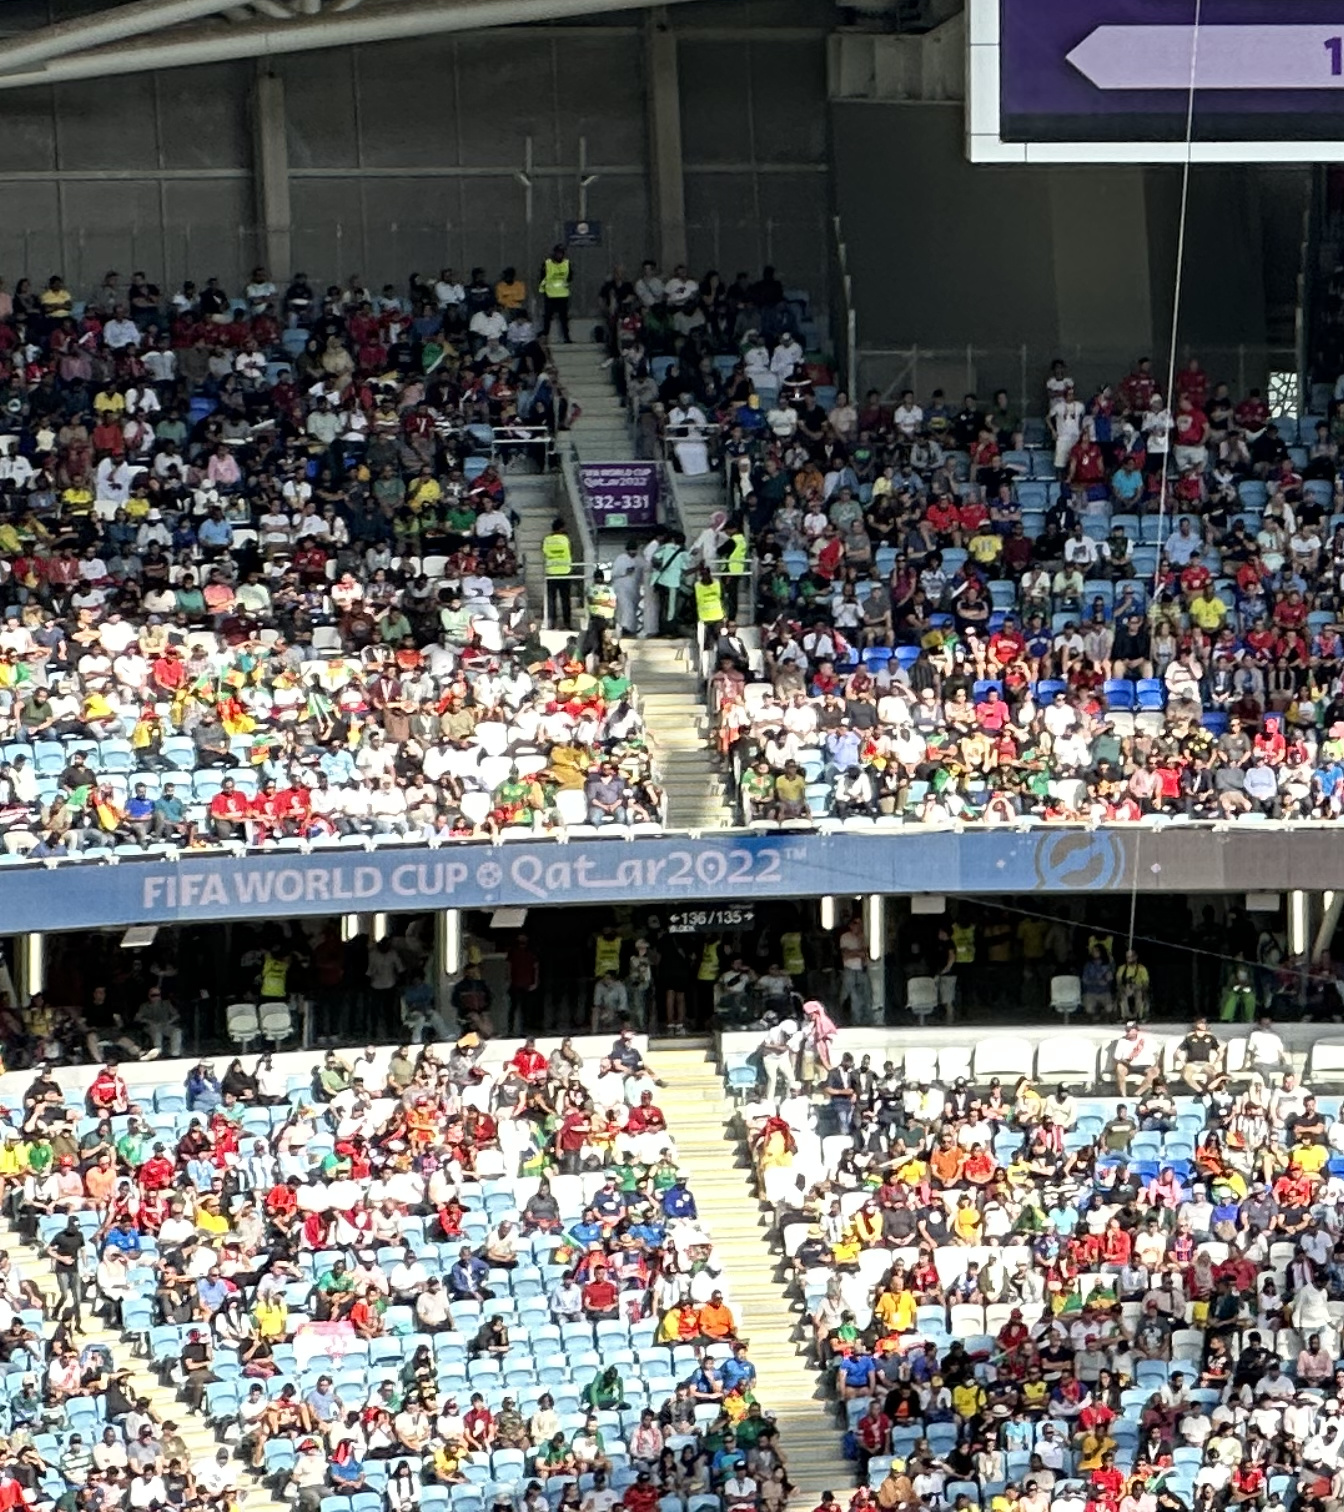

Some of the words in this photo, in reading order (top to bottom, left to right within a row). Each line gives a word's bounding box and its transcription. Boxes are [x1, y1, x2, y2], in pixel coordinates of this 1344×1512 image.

[143, 872, 230, 909] FIFA
[233, 865, 384, 904] WORLD
[391, 861, 469, 897] CUP
